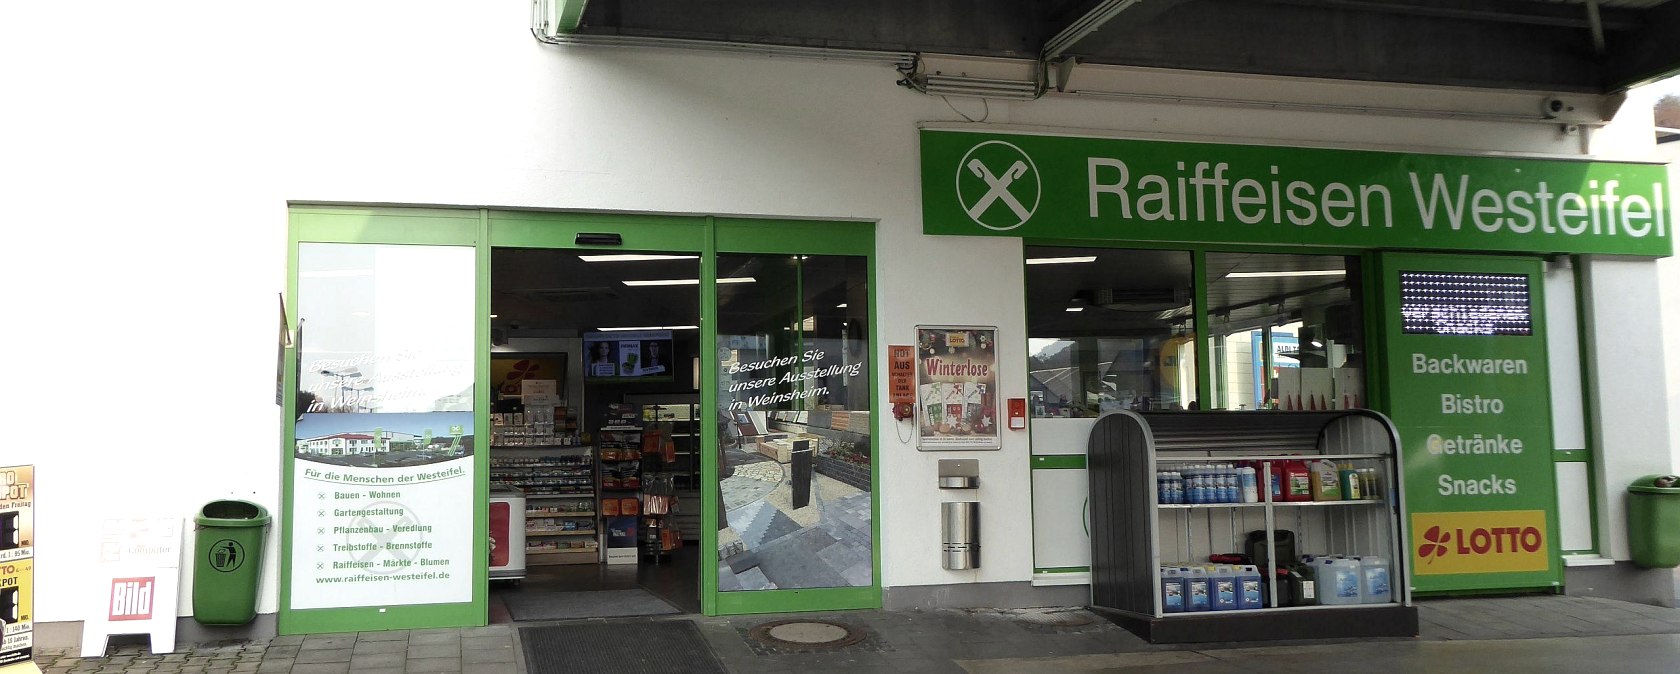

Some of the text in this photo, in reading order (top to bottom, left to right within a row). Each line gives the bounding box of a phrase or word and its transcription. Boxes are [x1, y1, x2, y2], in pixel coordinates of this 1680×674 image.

[1087, 156, 1666, 238] Raiffeisen Westeifel
[728, 348, 825, 374] Besuchen Sie
[894, 361, 910, 370] AUS
[926, 358, 988, 376] Winterlose
[1412, 353, 1527, 374] Backwaren
[728, 361, 862, 393] unsere Ausstellung
[307, 399, 324, 412] in
[728, 386, 830, 411] in Weinsheim.
[1441, 394, 1504, 414] Bistro
[1426, 433, 1523, 455] Getränke
[304, 466, 466, 483] Für die Menschen der Westeifel.
[1438, 474, 1517, 496] Snacks
[334, 491, 360, 500] Bauen
[368, 490, 401, 499] Wohnen
[334, 508, 404, 517] Gartengestaltung
[333, 525, 384, 534] Pflanzenbau
[392, 524, 432, 533] Veredlung
[333, 543, 377, 551] Treibstoffe
[386, 541, 433, 550] Brennstoffe
[1456, 526, 1542, 555] LOTTO
[332, 560, 374, 569] Raiffeisen
[383, 558, 412, 567] Märkte
[420, 557, 450, 566] Blumen
[0, 577, 18, 588] POT
[316, 572, 450, 584] www.raiffeisen-westeifel.de
[113, 581, 152, 616] Bild
